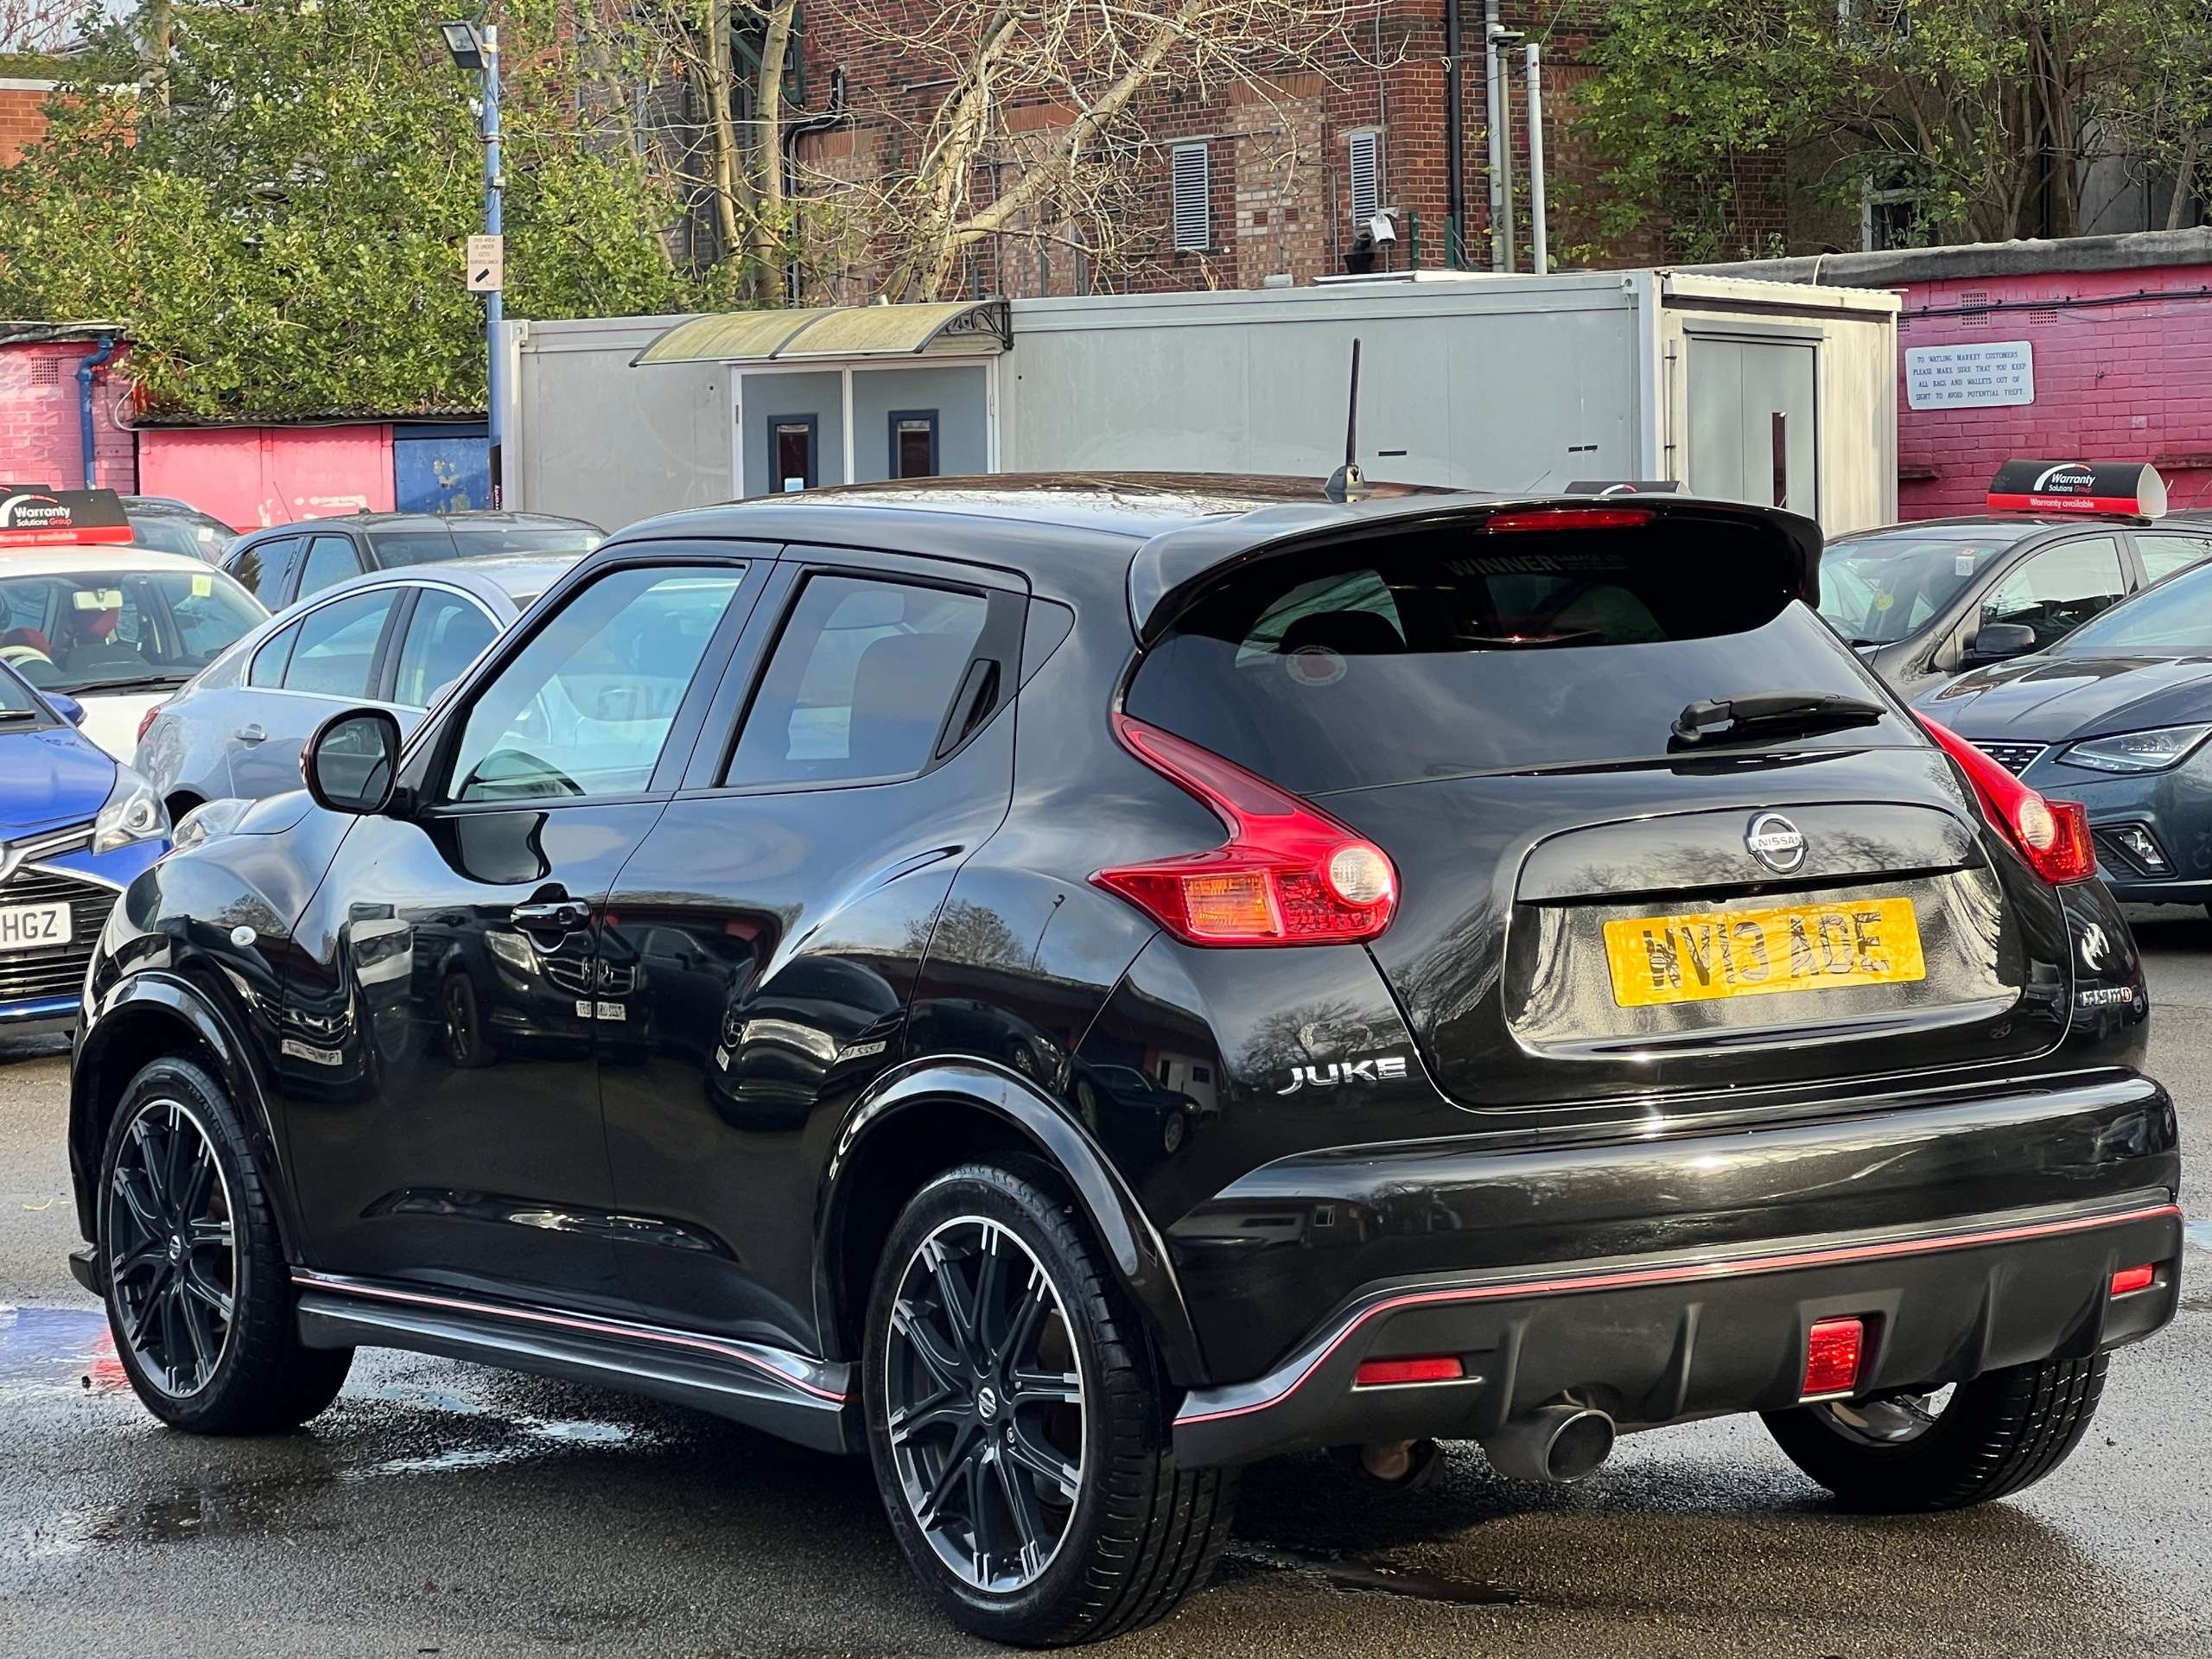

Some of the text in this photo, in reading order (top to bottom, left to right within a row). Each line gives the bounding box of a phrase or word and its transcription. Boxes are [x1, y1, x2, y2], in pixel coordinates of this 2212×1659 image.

[1947, 391, 1963, 399] AVOID
[1967, 390, 1999, 398] POTENTIAL
[2051, 474, 2095, 486] Warranty
[2030, 498, 2094, 509] Warranty available
[14, 506, 71, 518] Warranty
[16, 518, 48, 527] Solutions
[36, 532, 79, 542] available
[1441, 555, 1562, 576] WINNER
[1758, 836, 1802, 848] NISSAN
[3, 910, 58, 942] HGZ
[1276, 1057, 1408, 1096] JUKE
